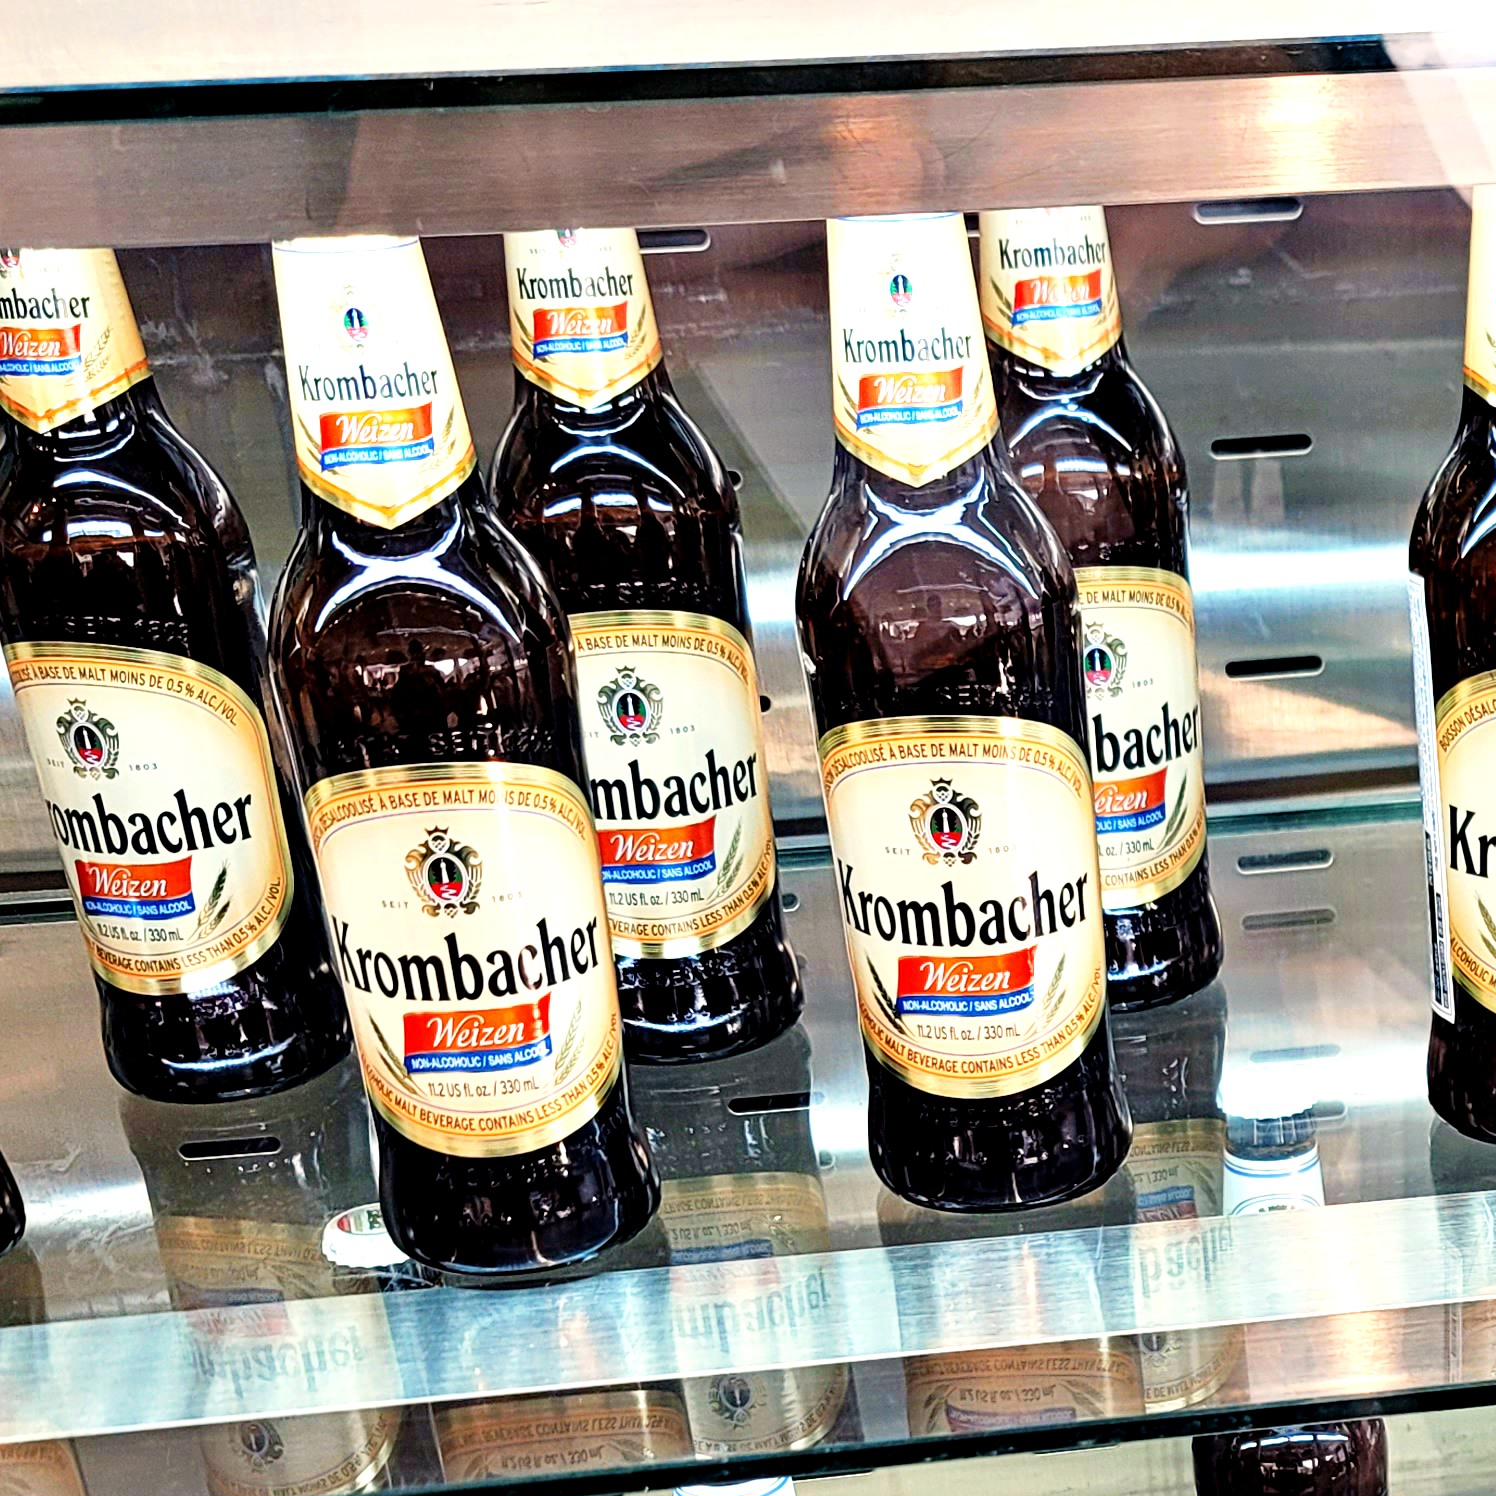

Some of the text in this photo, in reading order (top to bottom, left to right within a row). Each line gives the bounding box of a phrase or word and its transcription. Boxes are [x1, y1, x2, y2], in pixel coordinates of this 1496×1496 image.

[999, 234, 1105, 270] Krombacher
[516, 266, 633, 300] Krombacher
[0, 288, 90, 319] mbacher
[548, 310, 613, 335] Weizen
[0, 331, 60, 356] Weizen
[843, 327, 972, 363] Krombacher
[298, 362, 438, 401] Krombacher
[874, 375, 945, 404] Weizen
[335, 413, 414, 443] Weizen
[586, 636, 613, 650] BASE
[615, 634, 629, 648] DE
[632, 634, 658, 648] MALT
[662, 635, 693, 651] MOINS
[1091, 701, 1200, 773] bacher
[1439, 718, 1467, 752] BOISSON
[129, 762, 158, 771] 1803
[591, 748, 758, 821] mbacher
[46, 788, 252, 856] ombacher
[610, 832, 694, 862] Weizen
[86, 864, 168, 898] Weizen
[837, 857, 1088, 948] Krombacher
[331, 915, 599, 1002] Krombacher
[919, 961, 1011, 993] Weizen
[903, 992, 1032, 1013] NON-ALCOHOLIC SANS ALCOOL
[427, 1016, 525, 1048] Weizen
[934, 1025, 948, 1039] US
[984, 1025, 1002, 1039] 330
[411, 1043, 549, 1070] NON-ALCOHOLIC SANS ALCOOL
[884, 1030, 1064, 1073] MALT BEVERAGE CONTAINS LESS THAN
